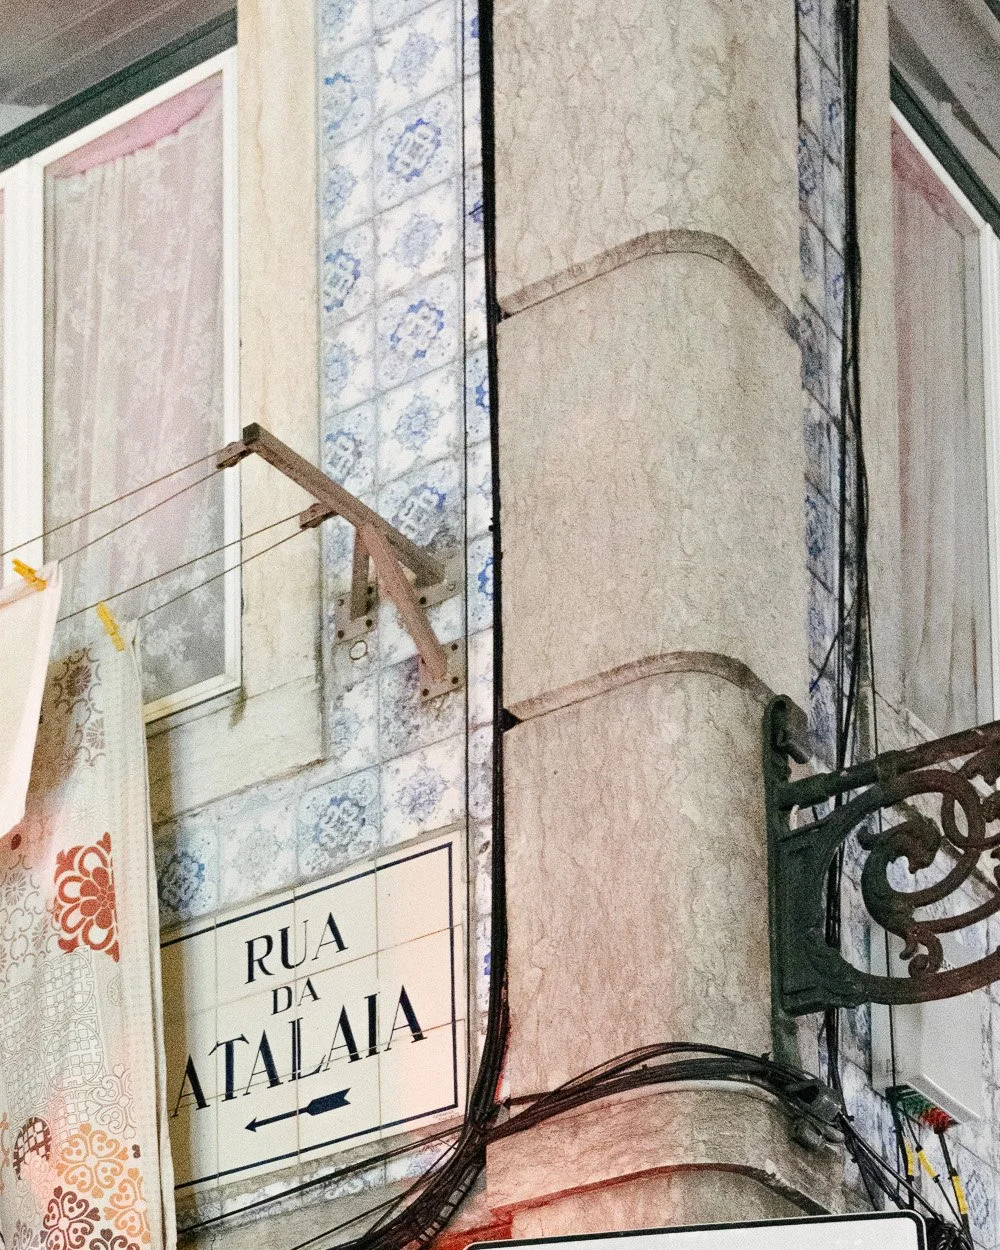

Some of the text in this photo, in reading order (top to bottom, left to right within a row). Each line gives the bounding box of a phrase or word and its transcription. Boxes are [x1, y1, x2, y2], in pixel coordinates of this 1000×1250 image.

[245, 912, 348, 984] RUA
[271, 977, 321, 1015] DA
[170, 985, 427, 1117] ATALAIA
